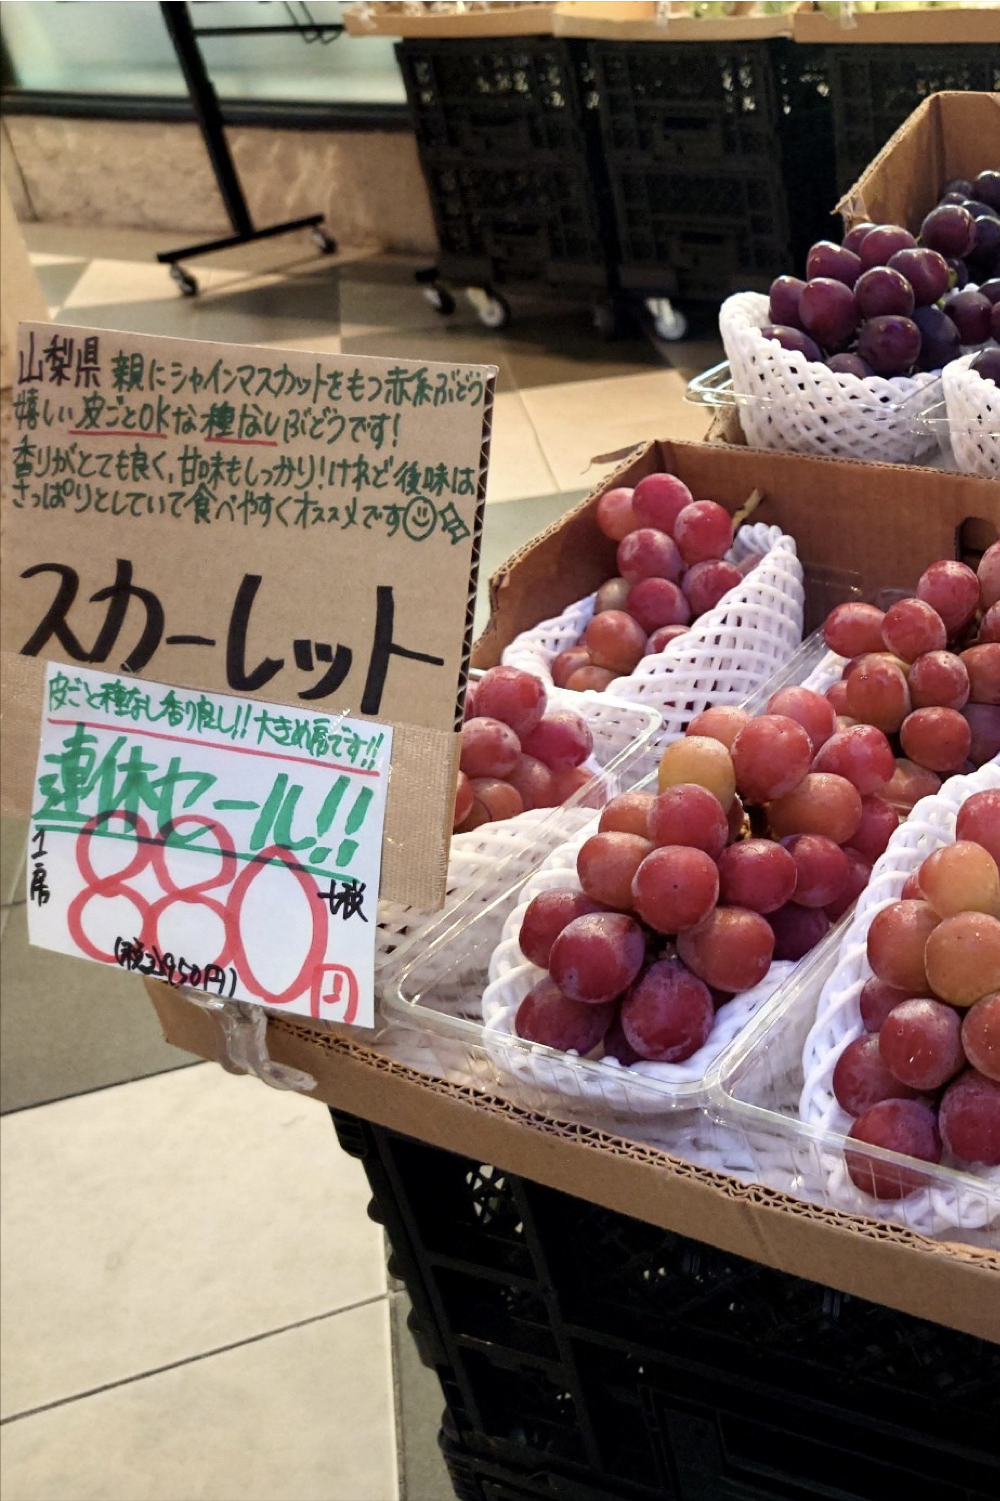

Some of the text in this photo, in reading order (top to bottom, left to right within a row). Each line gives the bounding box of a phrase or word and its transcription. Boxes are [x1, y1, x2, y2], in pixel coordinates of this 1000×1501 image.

[17, 330, 101, 389] 山梨県
[12, 481, 403, 537] さっぱりとしていて食べやすくオススメです
[19, 558, 445, 716] スカーレット
[31, 720, 375, 868] 連休セール!!
[66, 808, 360, 1025] 880円
